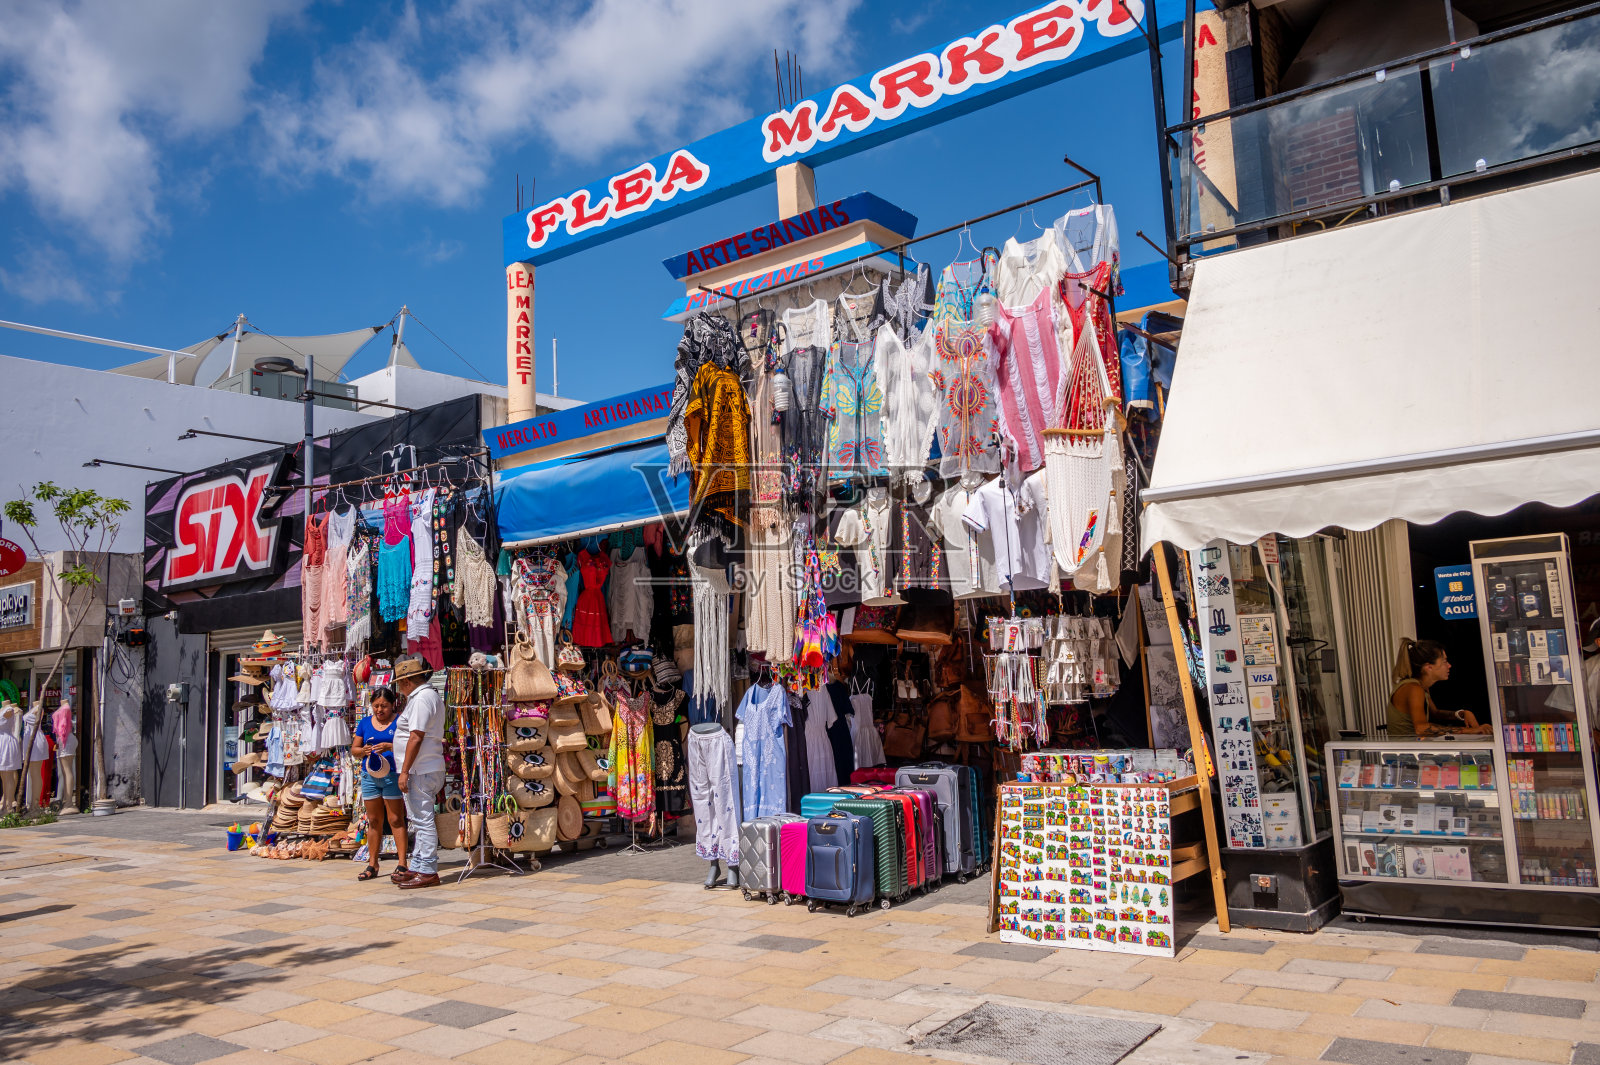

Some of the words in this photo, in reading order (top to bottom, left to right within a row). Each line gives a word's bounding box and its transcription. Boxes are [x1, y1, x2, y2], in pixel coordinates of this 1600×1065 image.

[529, 152, 706, 245] FLEA
[686, 200, 850, 277] ARTESANIAS
[507, 270, 535, 290] LEA
[685, 256, 825, 311] MEXICANAS
[516, 295, 532, 385] MARKET
[496, 421, 558, 450] MERCATO
[583, 389, 675, 429] ARTIGIANAT
[165, 467, 275, 584] SIX
[1445, 603, 1474, 615] AQUÍ
[1251, 674, 1274, 683] VISA
